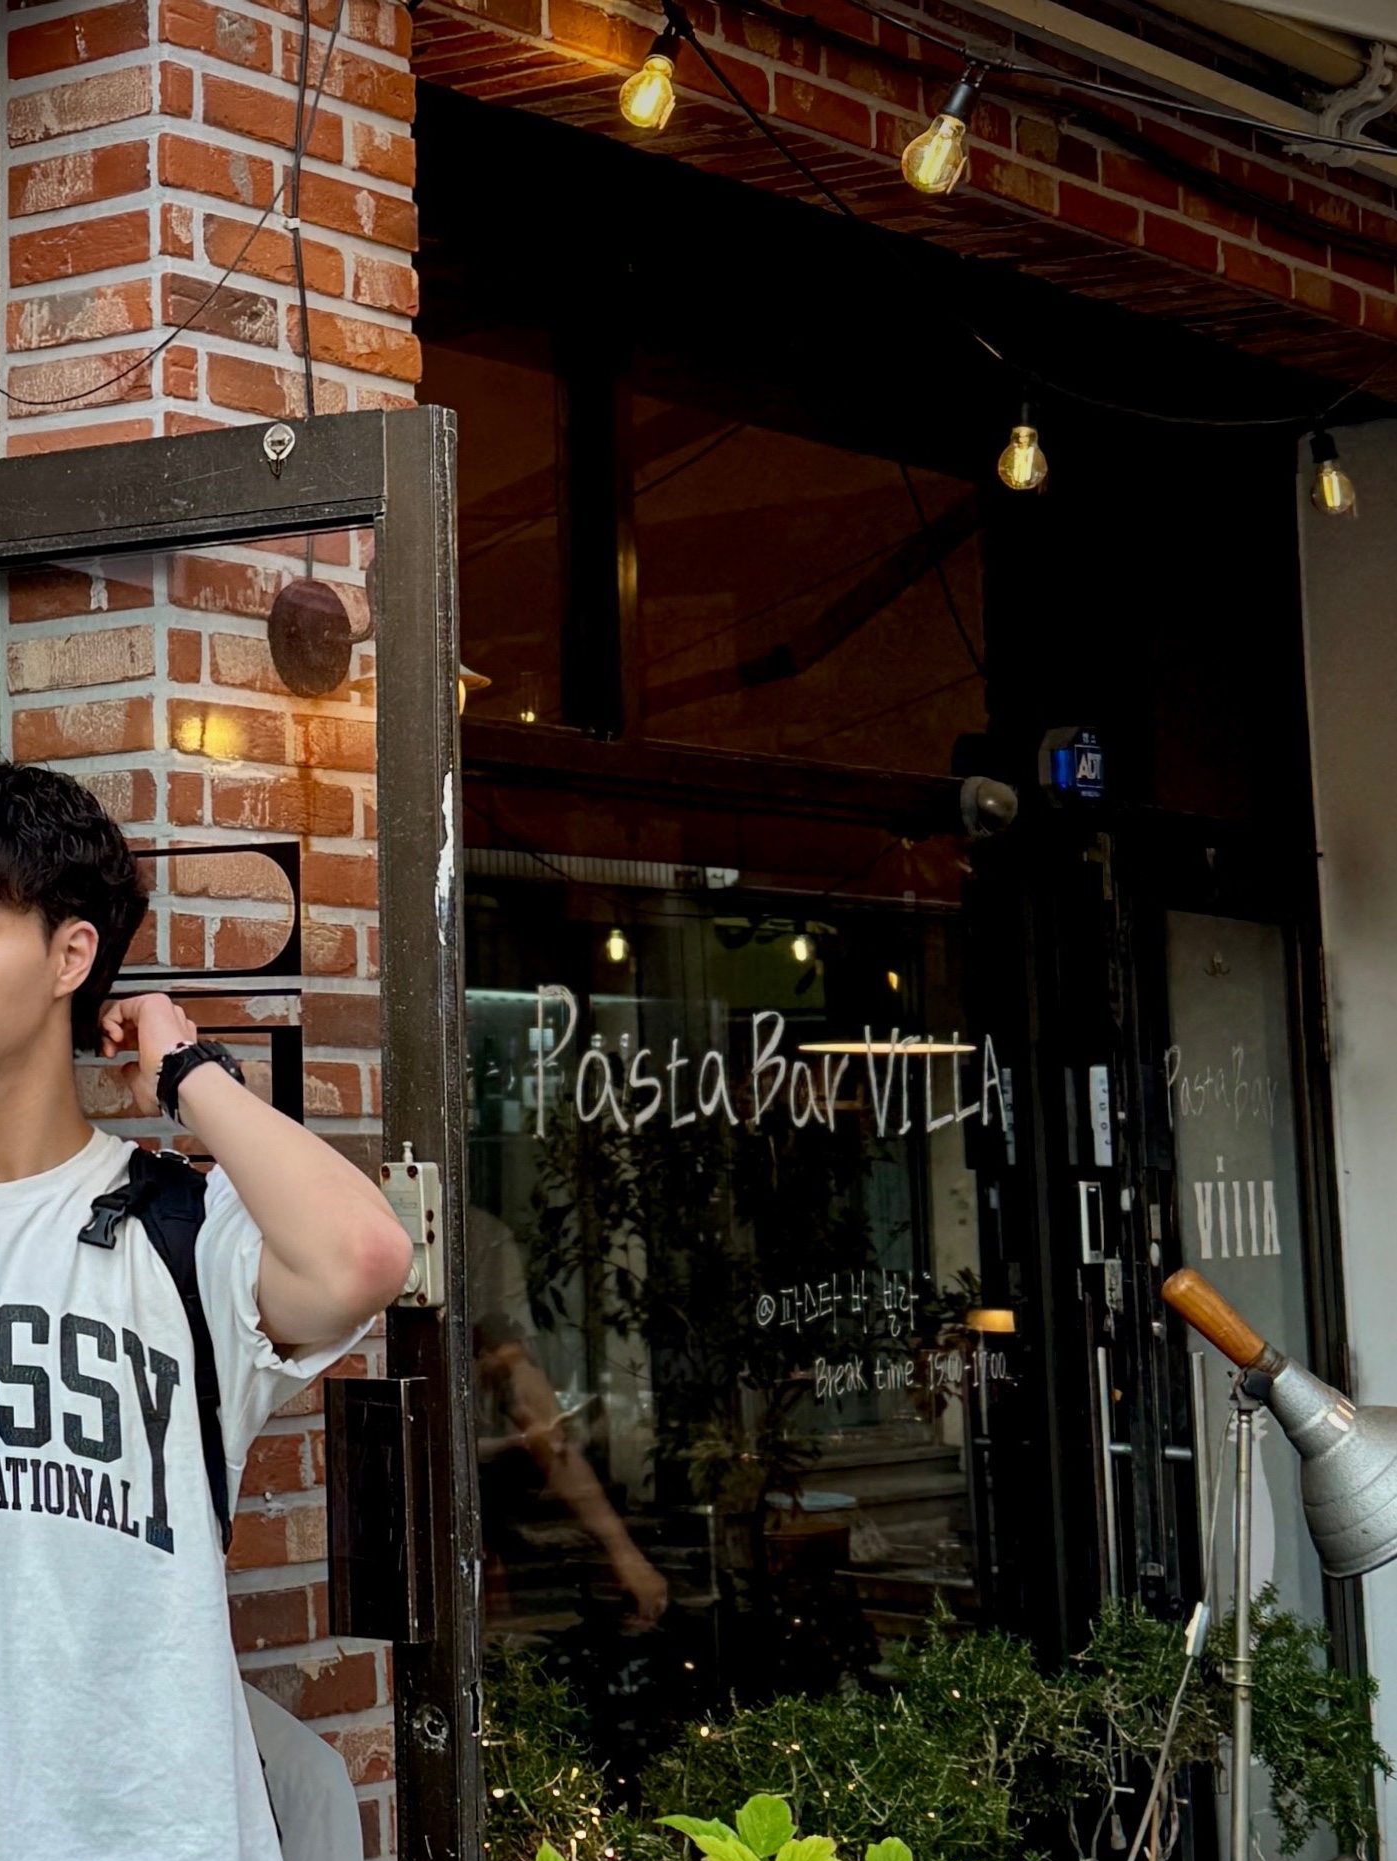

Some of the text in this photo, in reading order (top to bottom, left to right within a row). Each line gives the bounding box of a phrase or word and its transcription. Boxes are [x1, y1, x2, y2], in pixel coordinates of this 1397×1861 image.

[1076, 752, 1103, 780] ADT
[533, 984, 739, 1139] Pasta
[747, 1011, 850, 1134] Bar
[1163, 1044, 1231, 1132] Pasta
[851, 1270, 868, 1334] 바
[815, 1356, 868, 1399] Break
[874, 1359, 915, 1390] time
